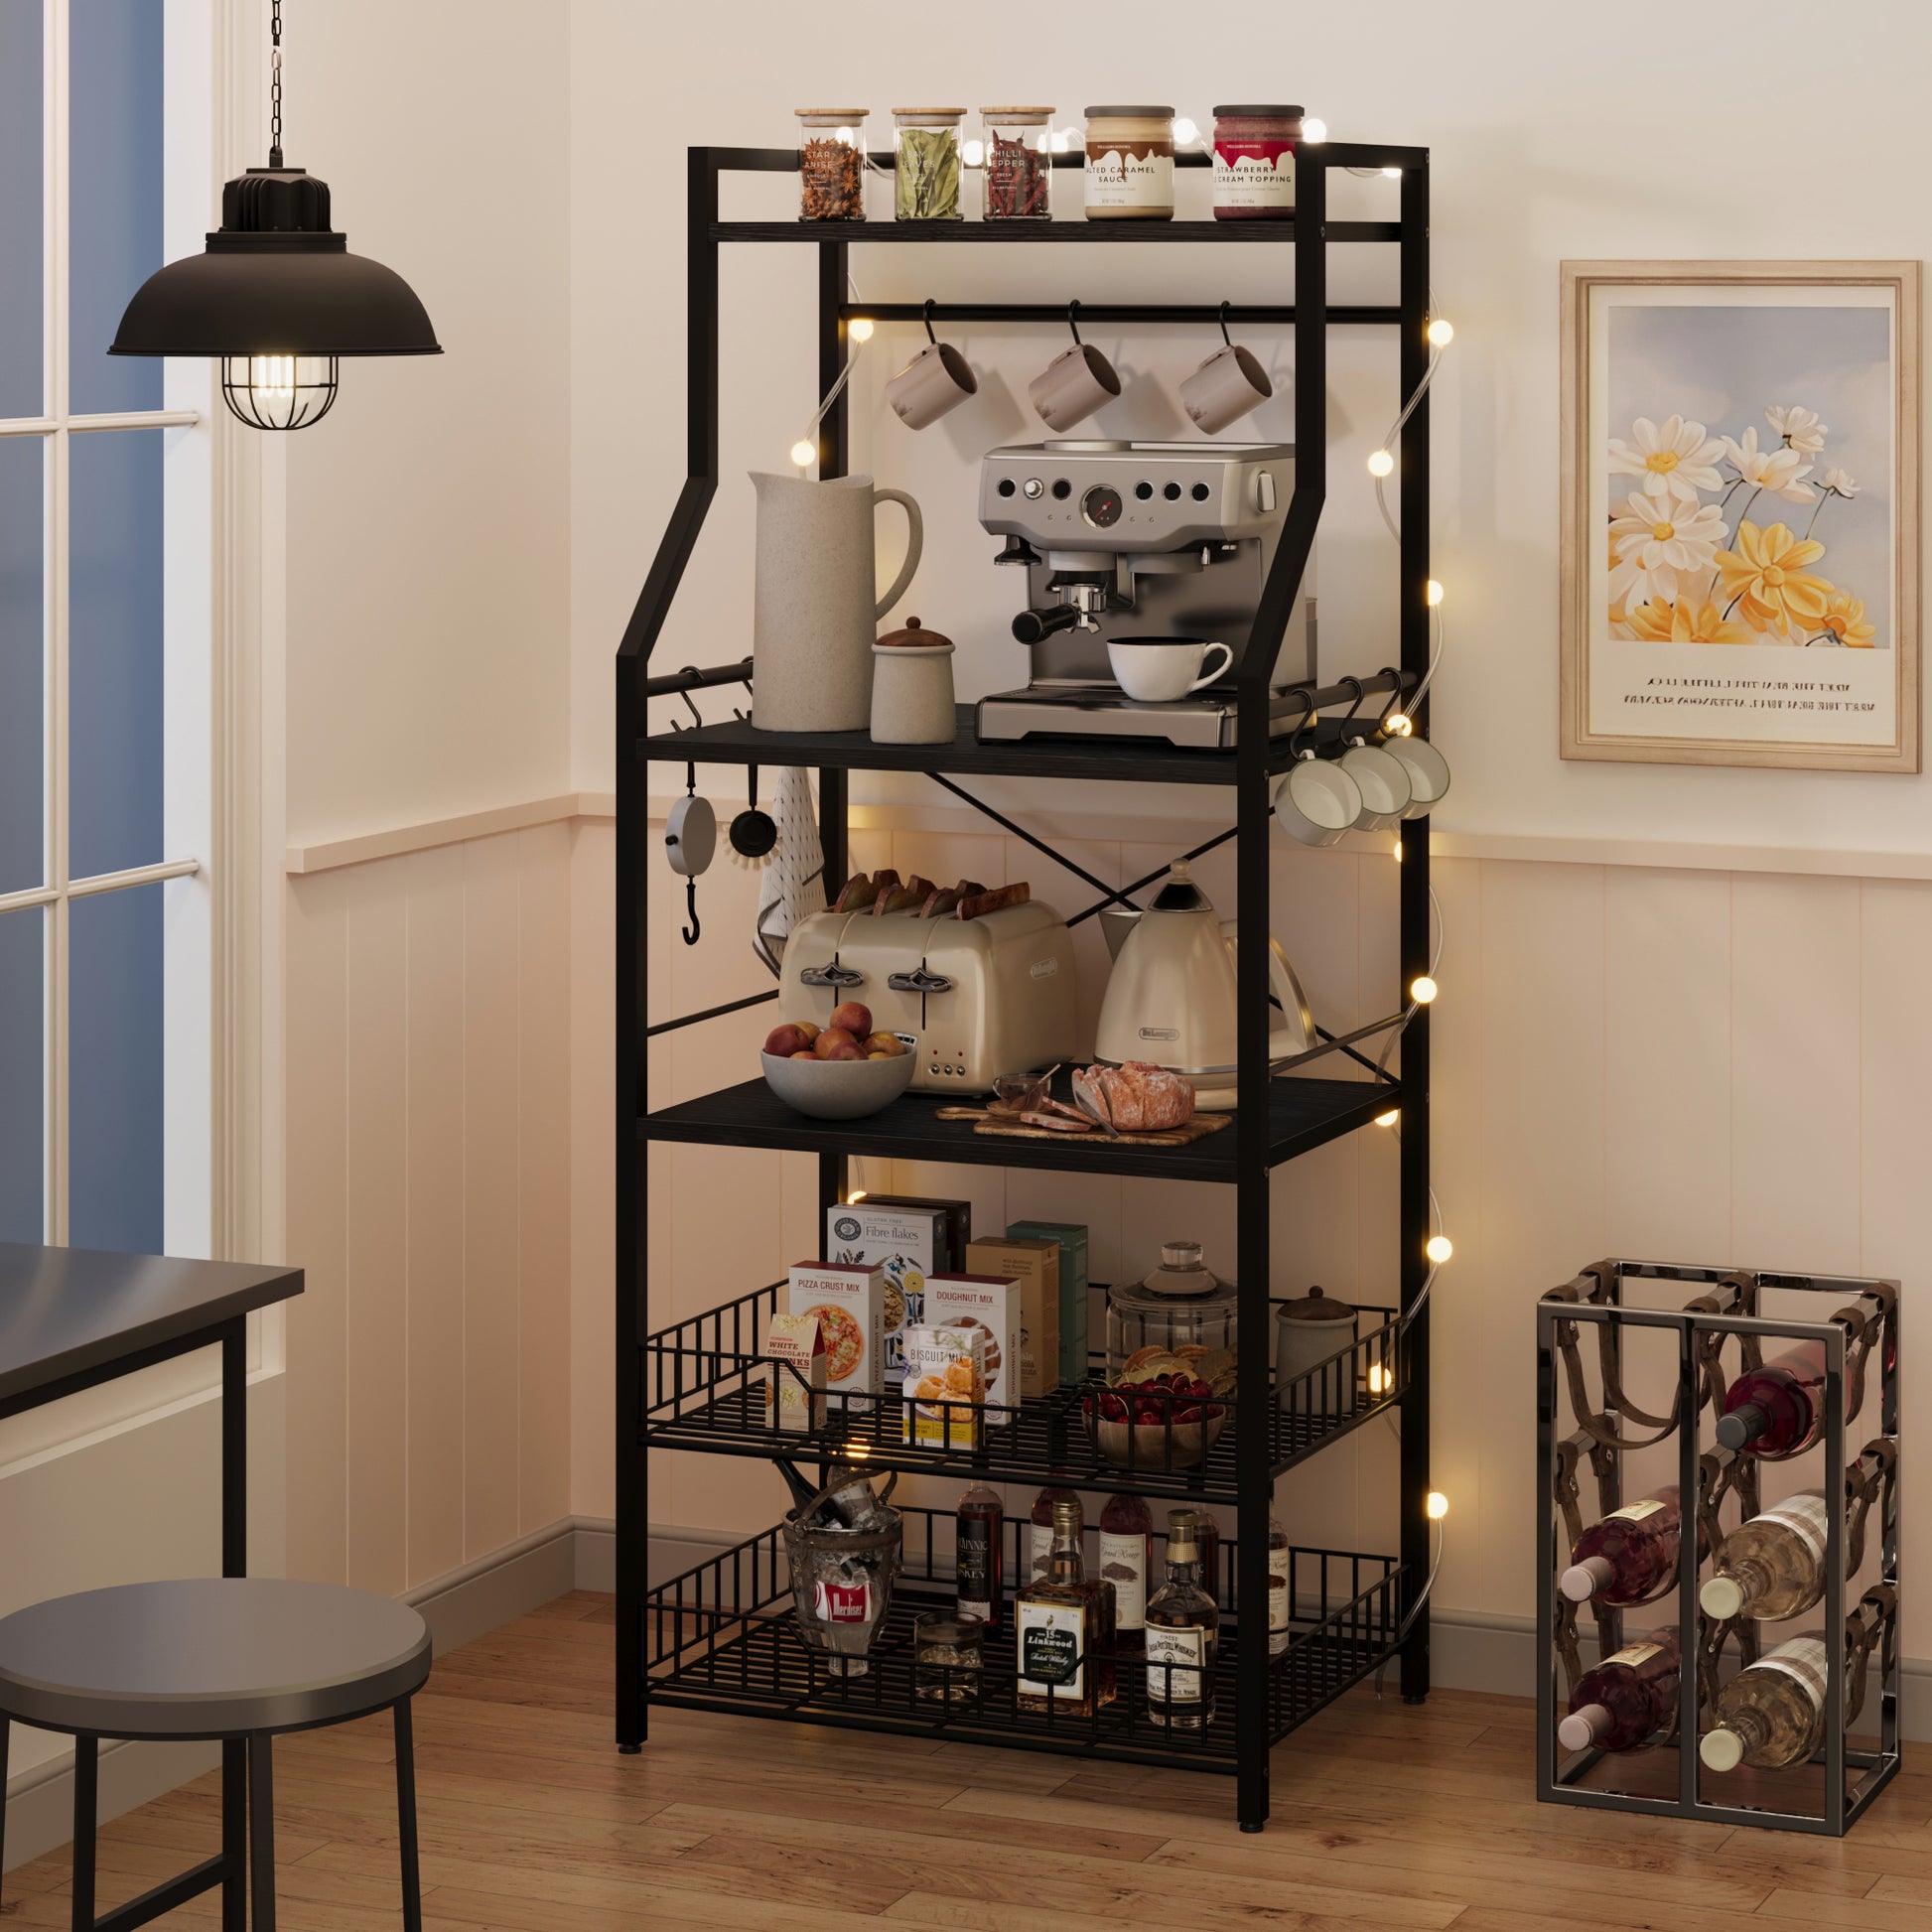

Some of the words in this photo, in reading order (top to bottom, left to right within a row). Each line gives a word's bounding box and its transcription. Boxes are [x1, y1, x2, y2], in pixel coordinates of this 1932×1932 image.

[866, 1225, 890, 1237] Fibre
[892, 1227, 919, 1240] flakes
[798, 1279, 819, 1289] PIZZA
[820, 1281, 844, 1291] CRUST
[846, 1283, 860, 1293] MIX
[937, 1291, 977, 1303] DOUGHNUT
[979, 1295, 993, 1304] MIX
[769, 1341, 798, 1350] WHITE
[767, 1349, 811, 1358] CHOCOLATE
[910, 1349, 944, 1362] BISCUIT
[948, 1353, 964, 1364] MIX
[1046, 1630, 1056, 1639] 15
[1028, 1636, 1073, 1648] Linkwood
